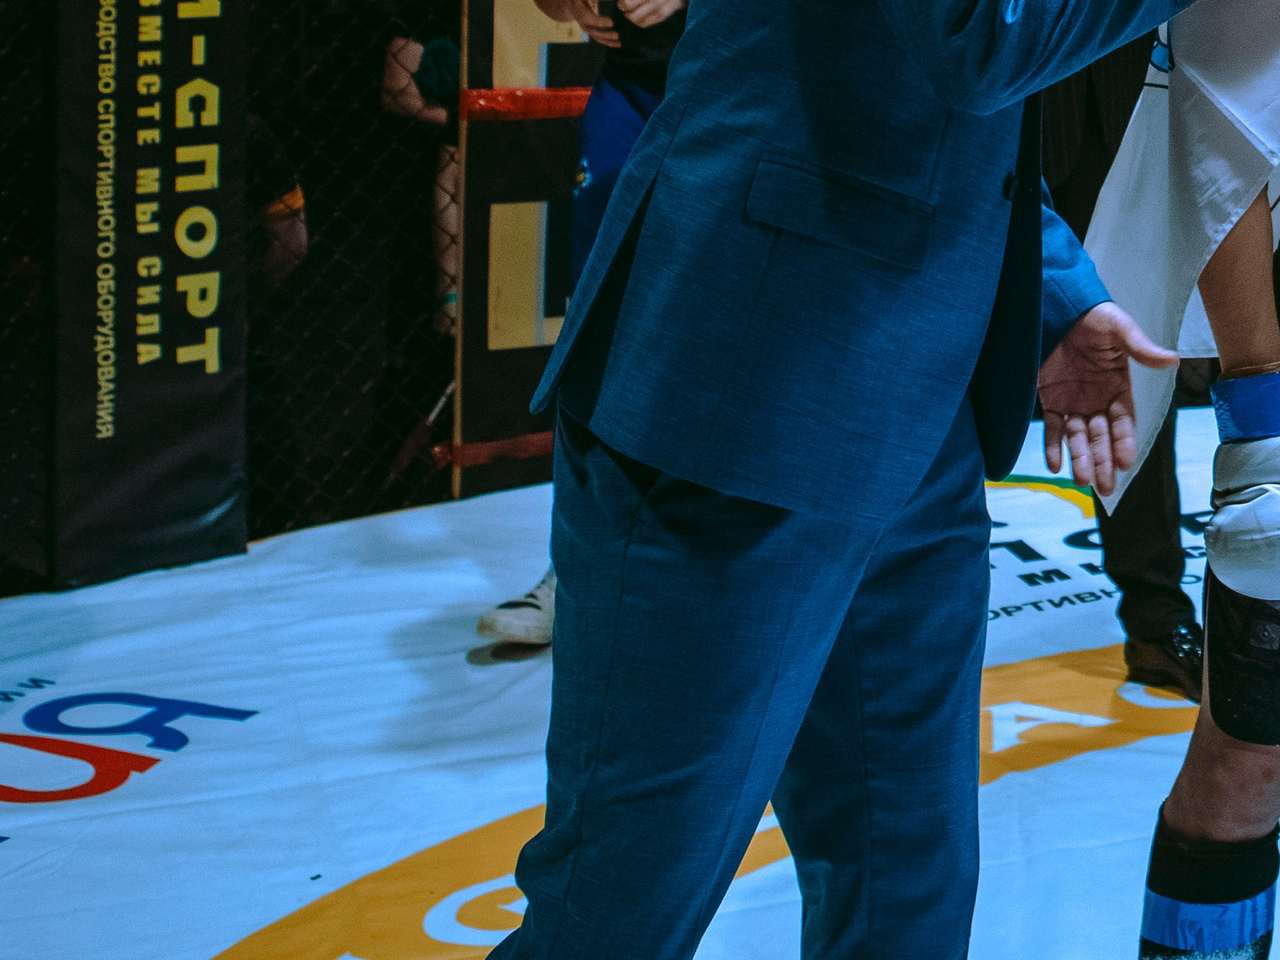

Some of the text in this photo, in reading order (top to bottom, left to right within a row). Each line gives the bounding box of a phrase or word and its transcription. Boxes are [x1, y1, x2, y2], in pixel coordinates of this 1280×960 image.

[96, 99, 116, 259] СПОРТИВНОГО
[136, 167, 161, 234] МЫ
[94, 263, 117, 439] ОБОРУДОВАНИЯ
[137, 256, 163, 365] СИЛА
